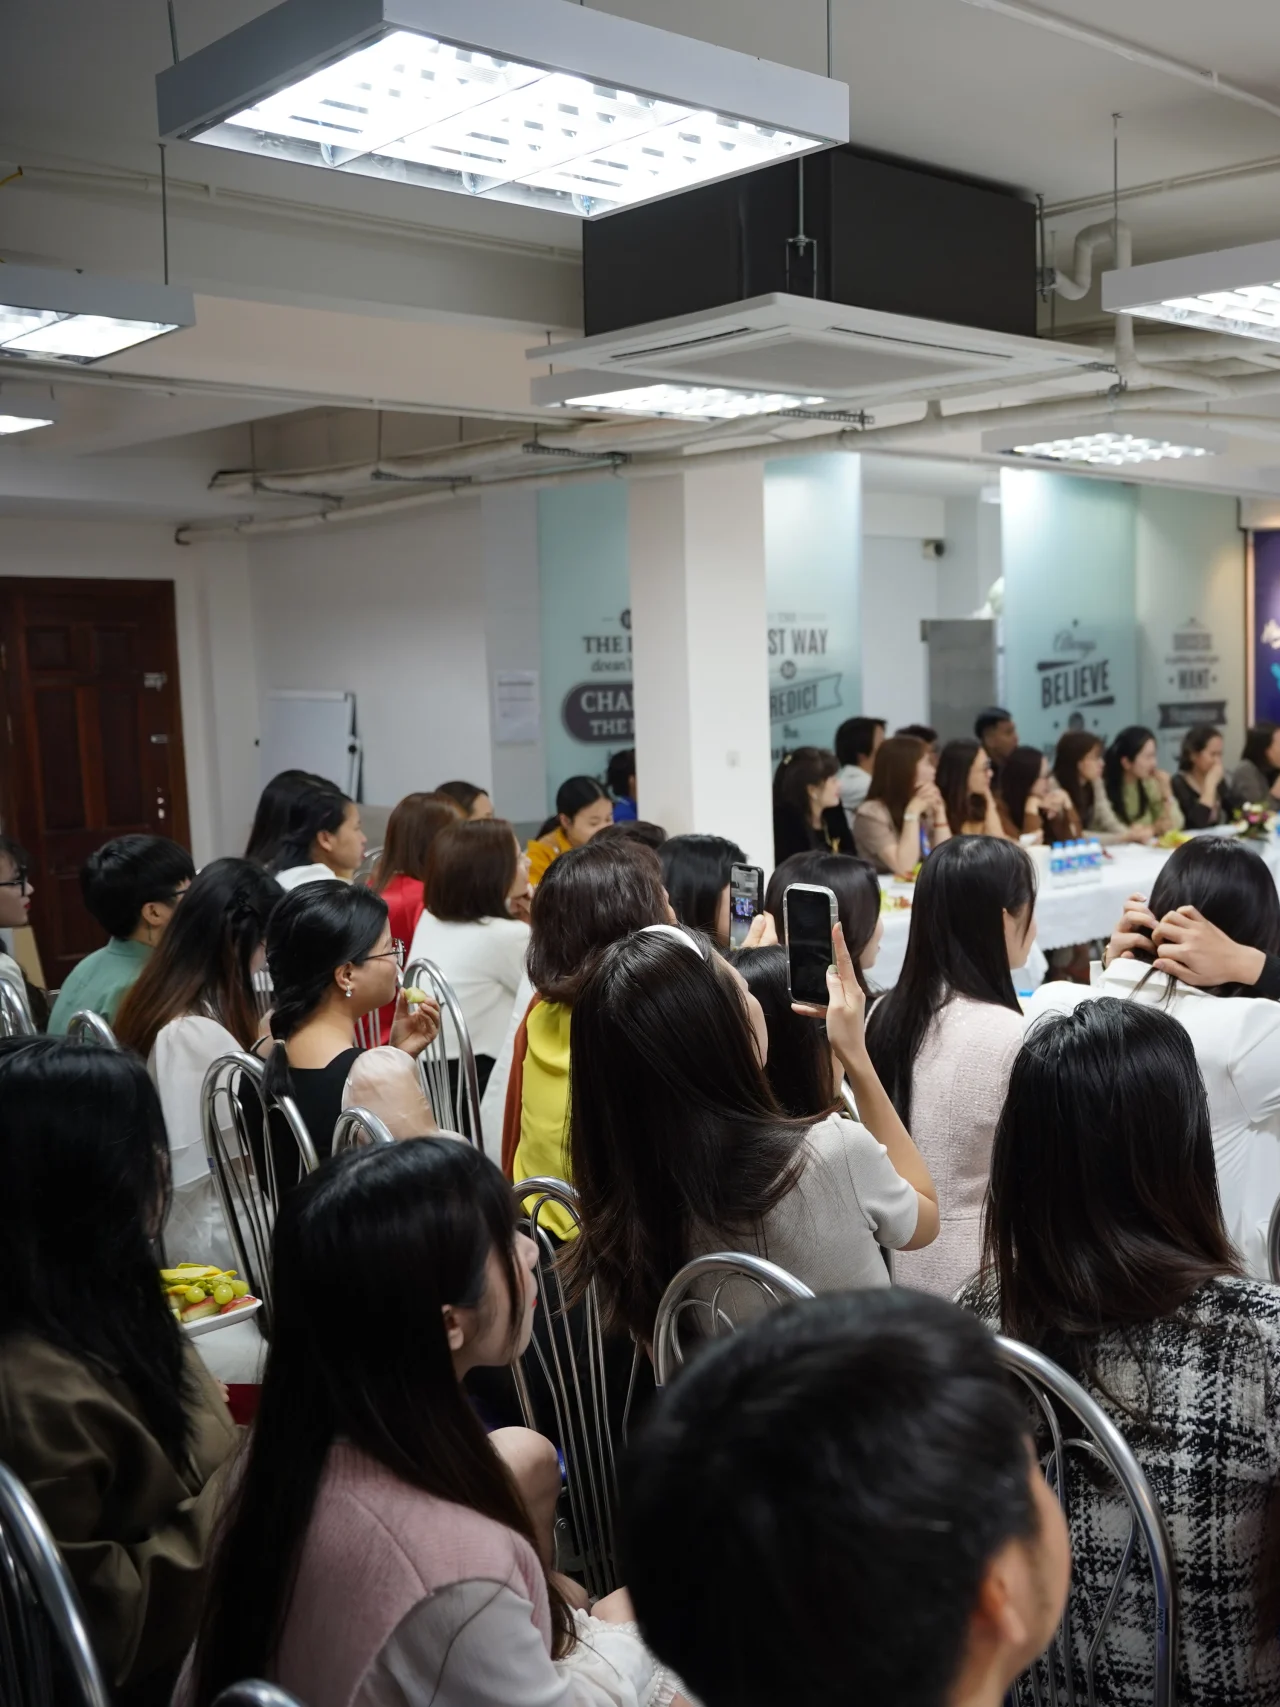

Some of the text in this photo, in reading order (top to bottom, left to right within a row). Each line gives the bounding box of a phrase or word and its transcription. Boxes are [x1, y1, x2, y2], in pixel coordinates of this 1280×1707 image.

[582, 635, 623, 653] THE
[791, 629, 828, 655] WAY
[1041, 660, 1109, 710] BELIEVE
[580, 690, 633, 713] CHA
[770, 684, 818, 720] REDICT
[589, 719, 627, 736] THE
